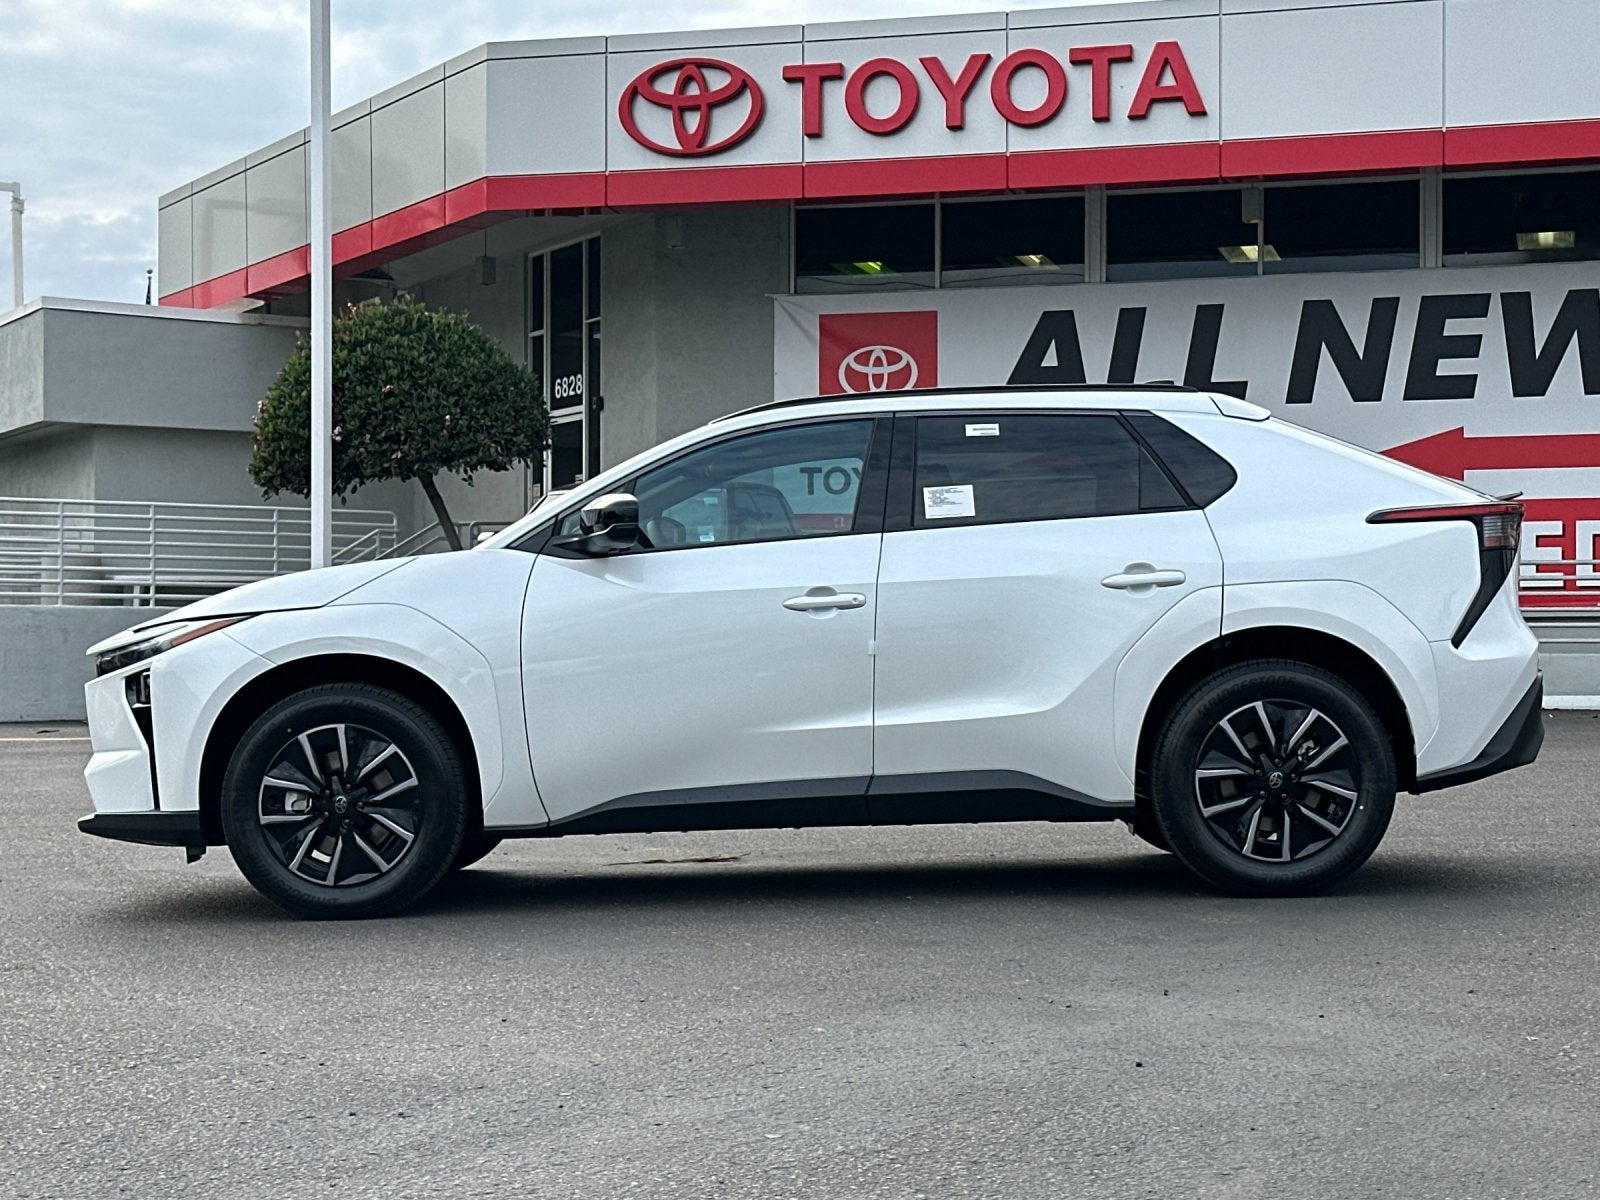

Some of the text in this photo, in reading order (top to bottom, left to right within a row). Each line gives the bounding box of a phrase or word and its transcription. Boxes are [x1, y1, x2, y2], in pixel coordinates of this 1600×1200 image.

[783, 41, 1207, 138] TOYOTA
[554, 374, 583, 399] 6828
[1006, 289, 1600, 404] ALL NEW
